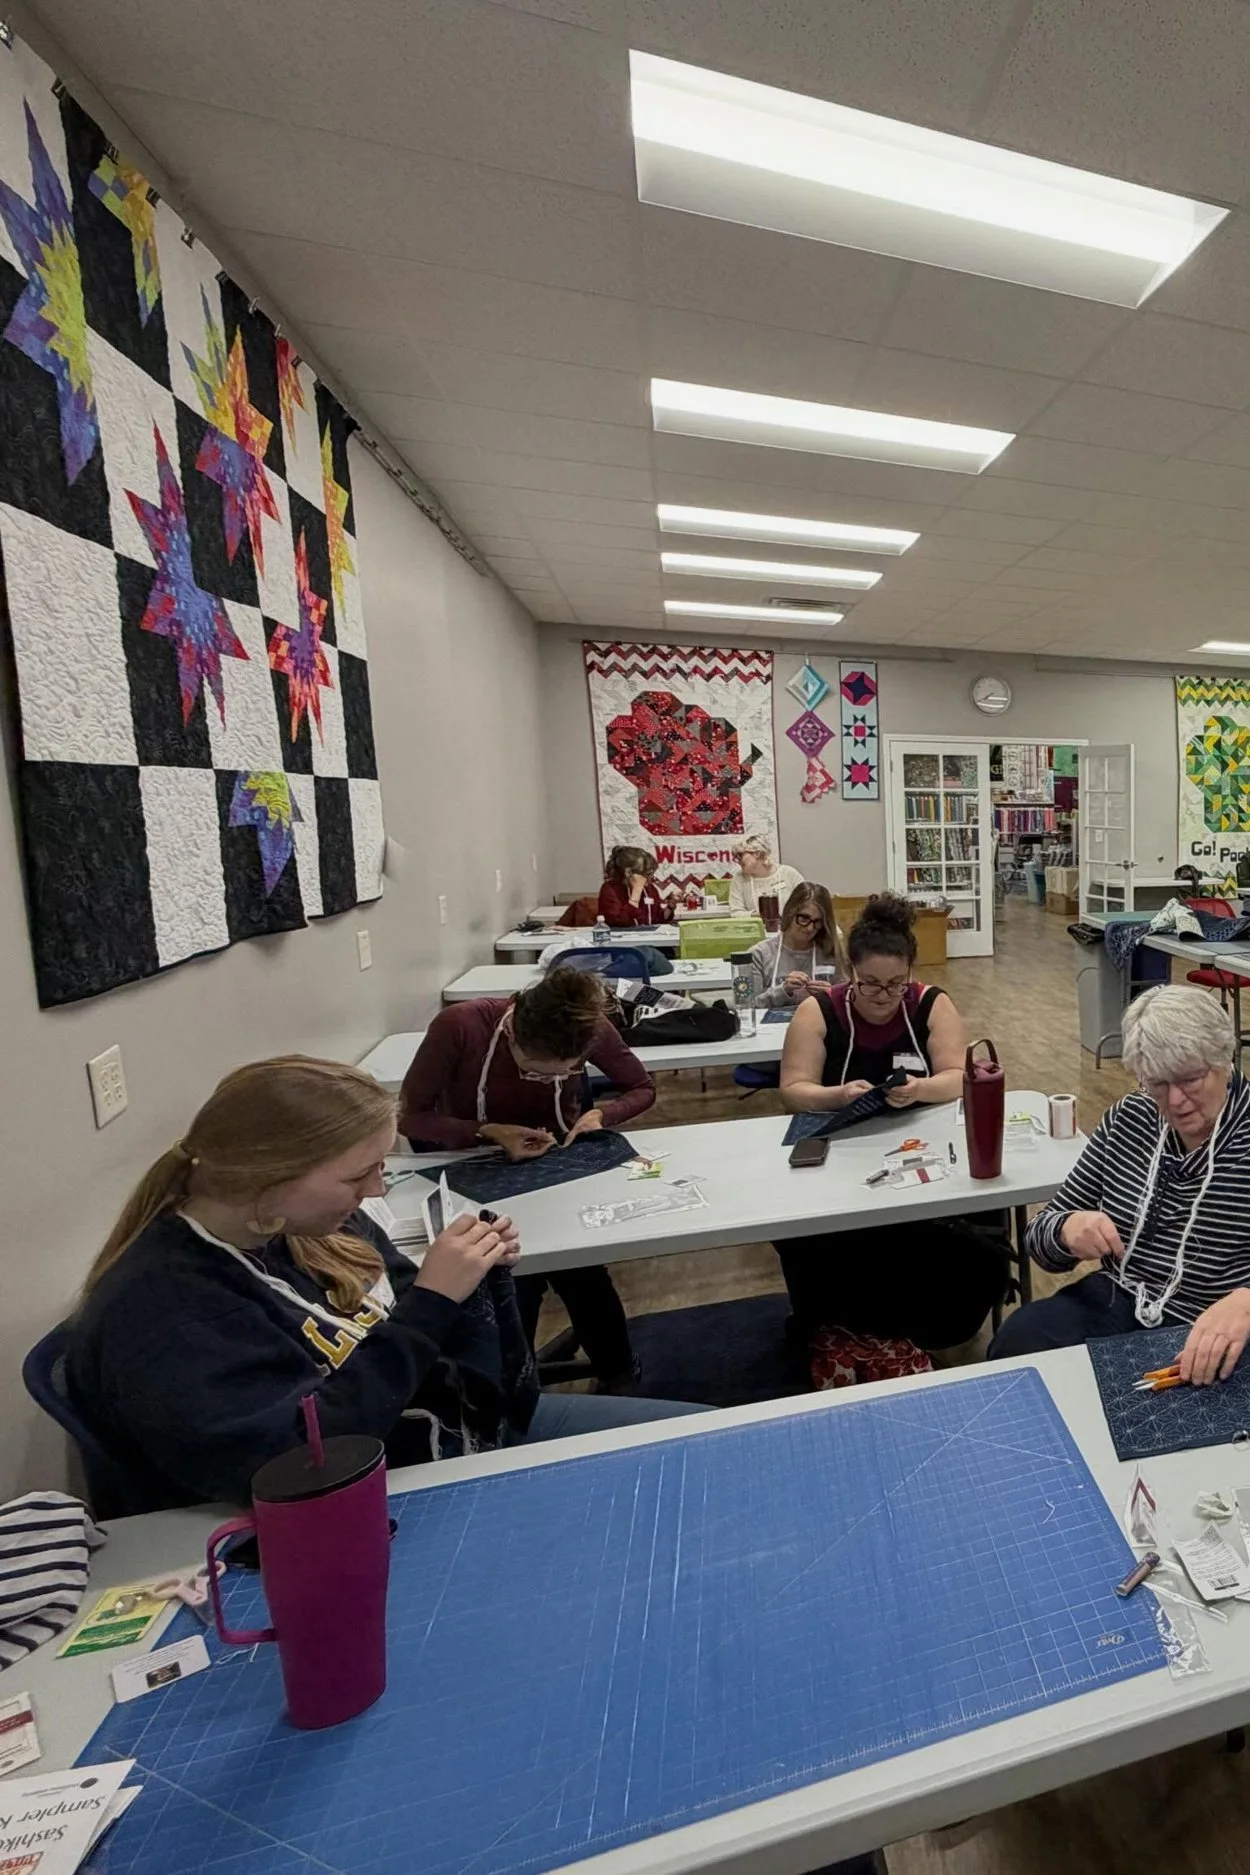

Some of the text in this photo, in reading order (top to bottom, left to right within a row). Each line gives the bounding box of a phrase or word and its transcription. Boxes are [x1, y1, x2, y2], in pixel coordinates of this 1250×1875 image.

[655, 845, 734, 864] Wiscon
[1191, 840, 1249, 863] Go! Pac
[16, 1796, 105, 1822] Sampler
